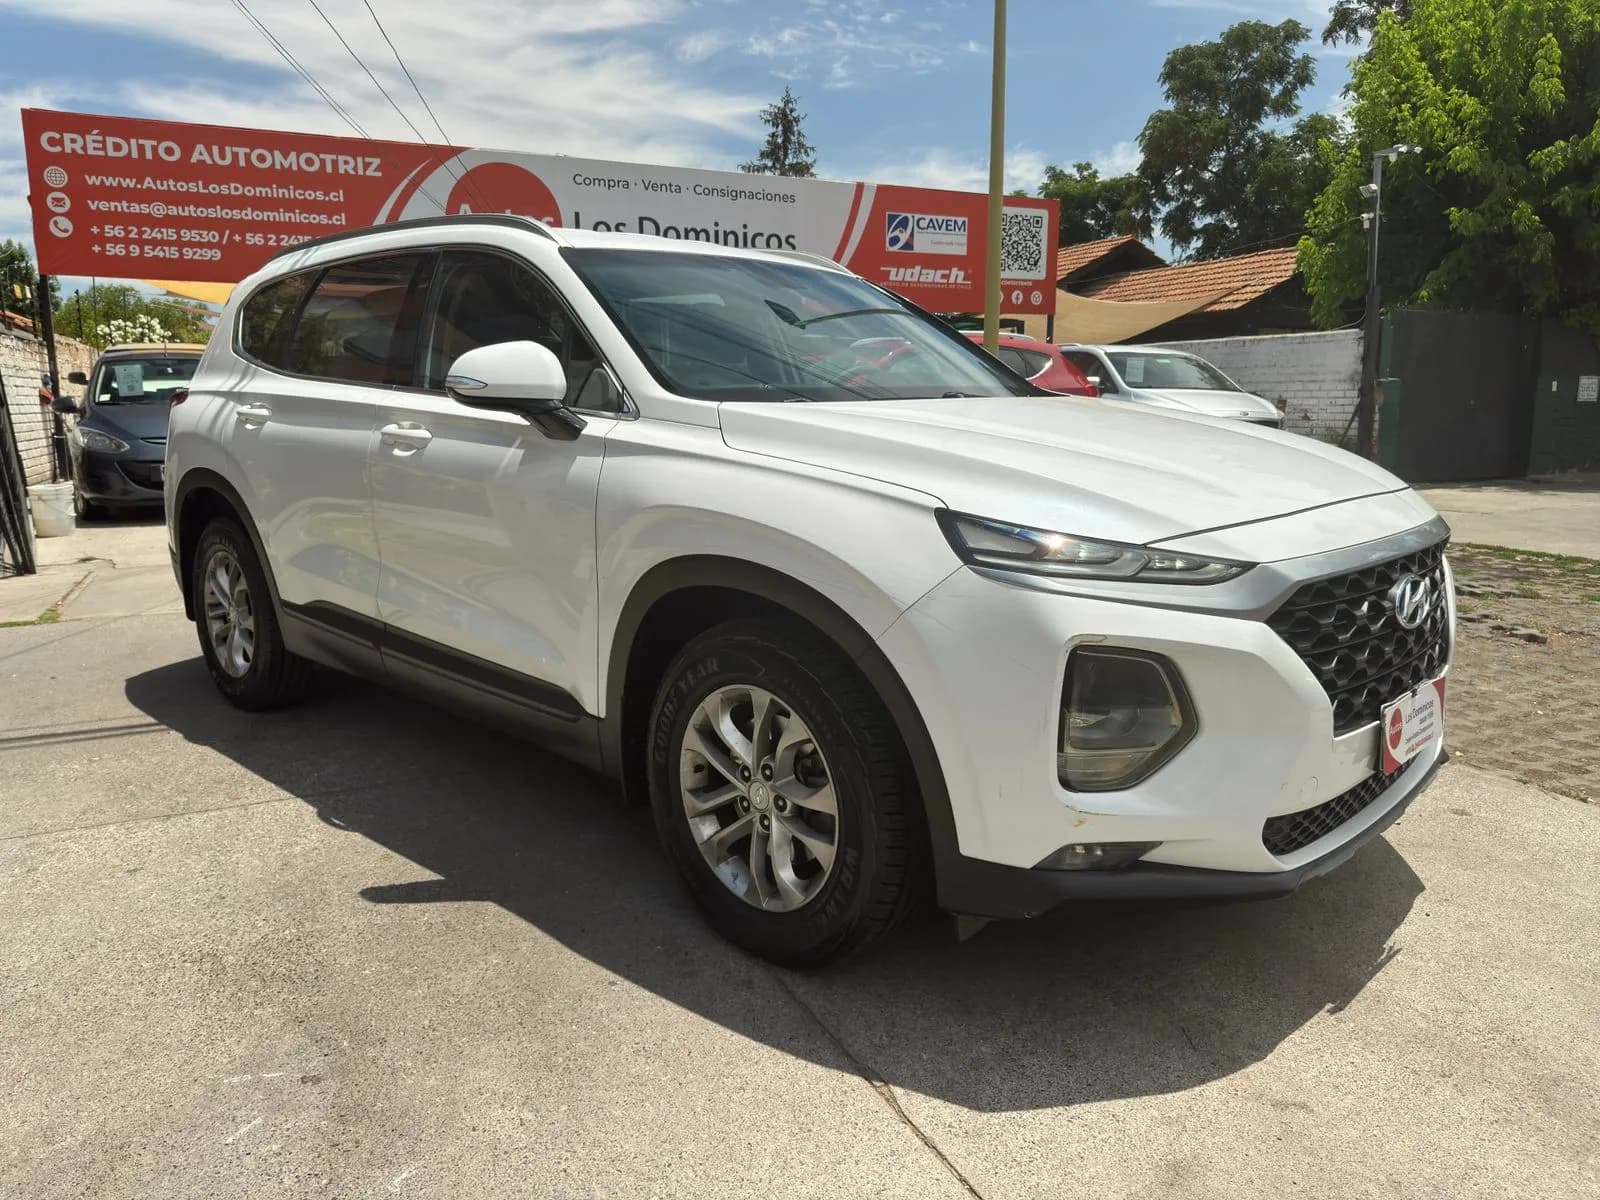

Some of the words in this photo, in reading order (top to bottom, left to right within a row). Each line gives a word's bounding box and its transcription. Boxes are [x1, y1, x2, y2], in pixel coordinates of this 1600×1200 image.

[40, 129, 182, 162] CRÉDITO
[190, 144, 382, 177] AUTOMOTRIZ
[84, 174, 344, 202] www.AutosLosDominicos.cl
[573, 173, 630, 190] Compra
[641, 179, 682, 194] Venta
[693, 184, 796, 204] Consignaciones
[87, 200, 346, 225] ventas@autoslosdominicos.cl
[104, 225, 125, 238] 56
[128, 226, 139, 238] 2
[142, 227, 178, 240] 2415
[180, 229, 219, 242] 9530
[245, 233, 265, 246] 56
[267, 234, 277, 246] 2
[916, 217, 967, 232] CAVEM
[105, 243, 126, 256] 56
[129, 245, 140, 257] 9
[143, 245, 179, 259] 5415
[182, 247, 221, 260] 9299
[880, 265, 972, 284] udach
